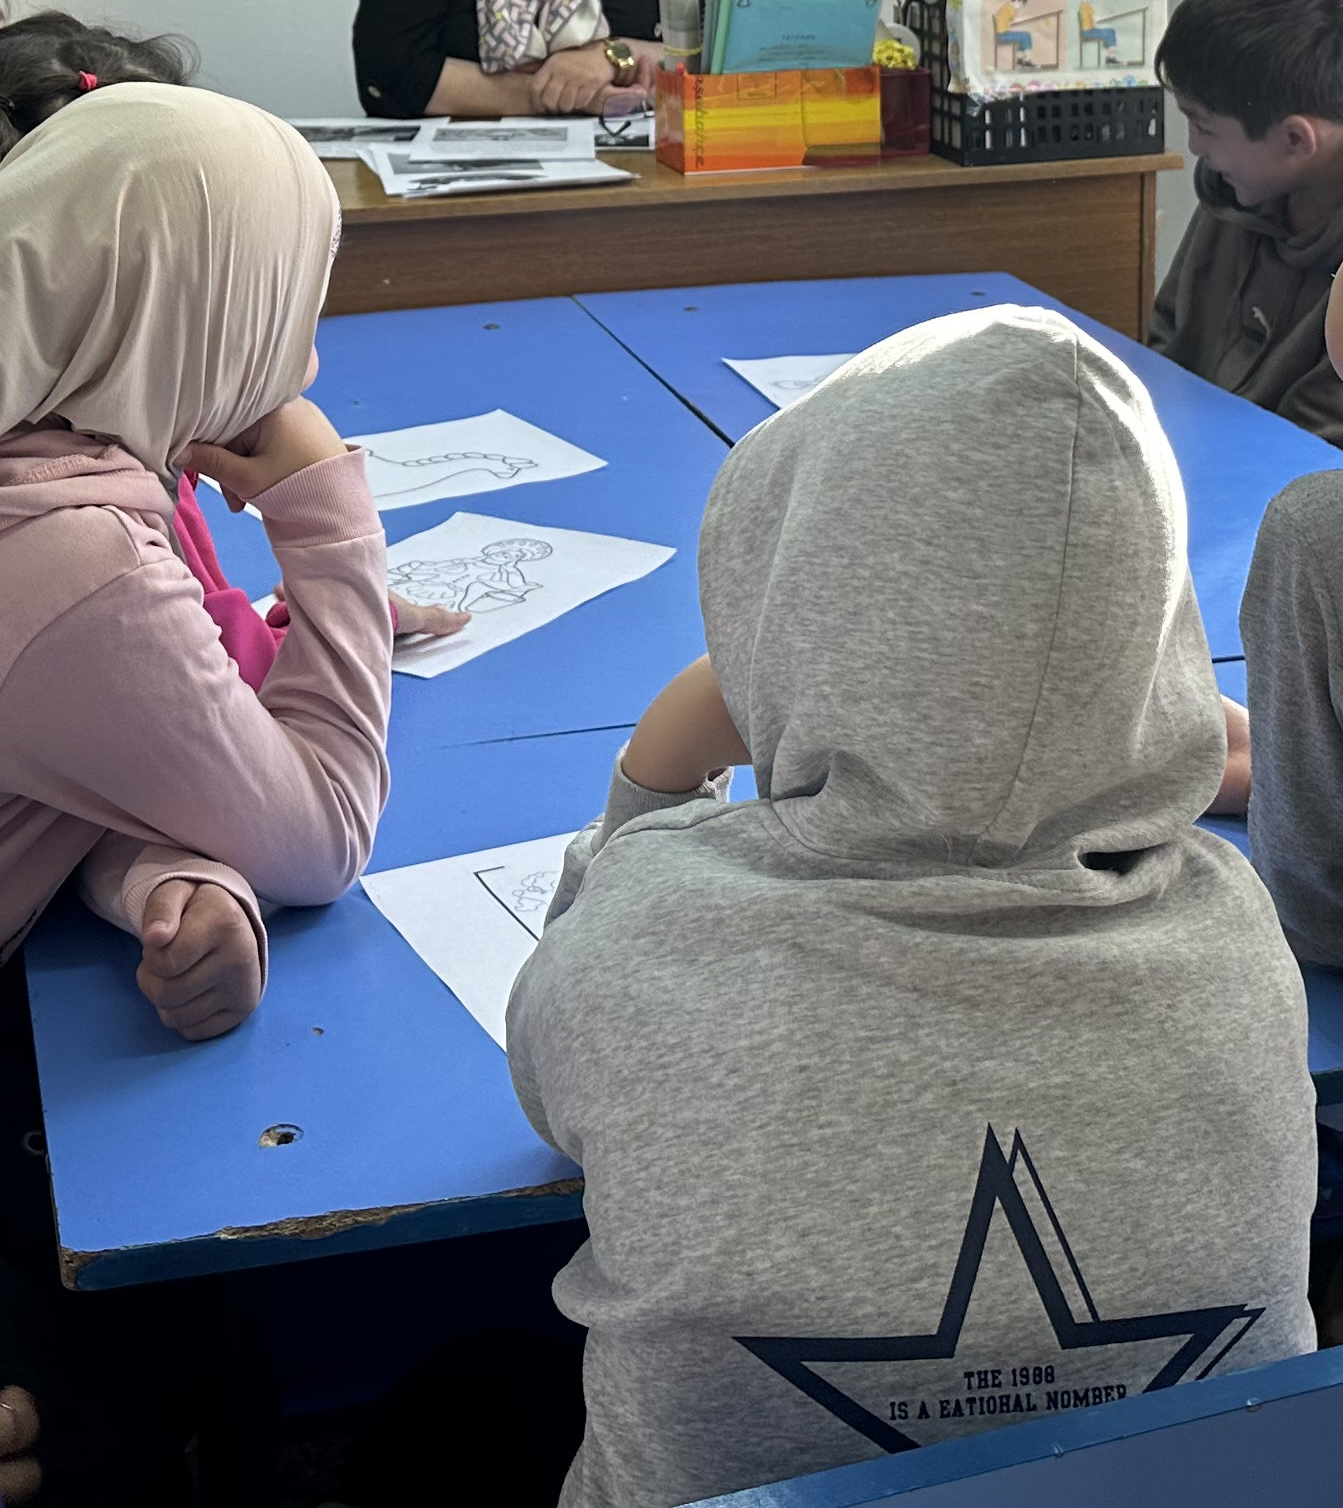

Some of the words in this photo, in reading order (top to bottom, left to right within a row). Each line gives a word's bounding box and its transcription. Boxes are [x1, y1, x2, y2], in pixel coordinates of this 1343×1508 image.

[963, 1368, 1003, 1391] THE
[1011, 1364, 1056, 1388] 1988
[889, 1400, 909, 1421] IS
[917, 1400, 931, 1420] A
